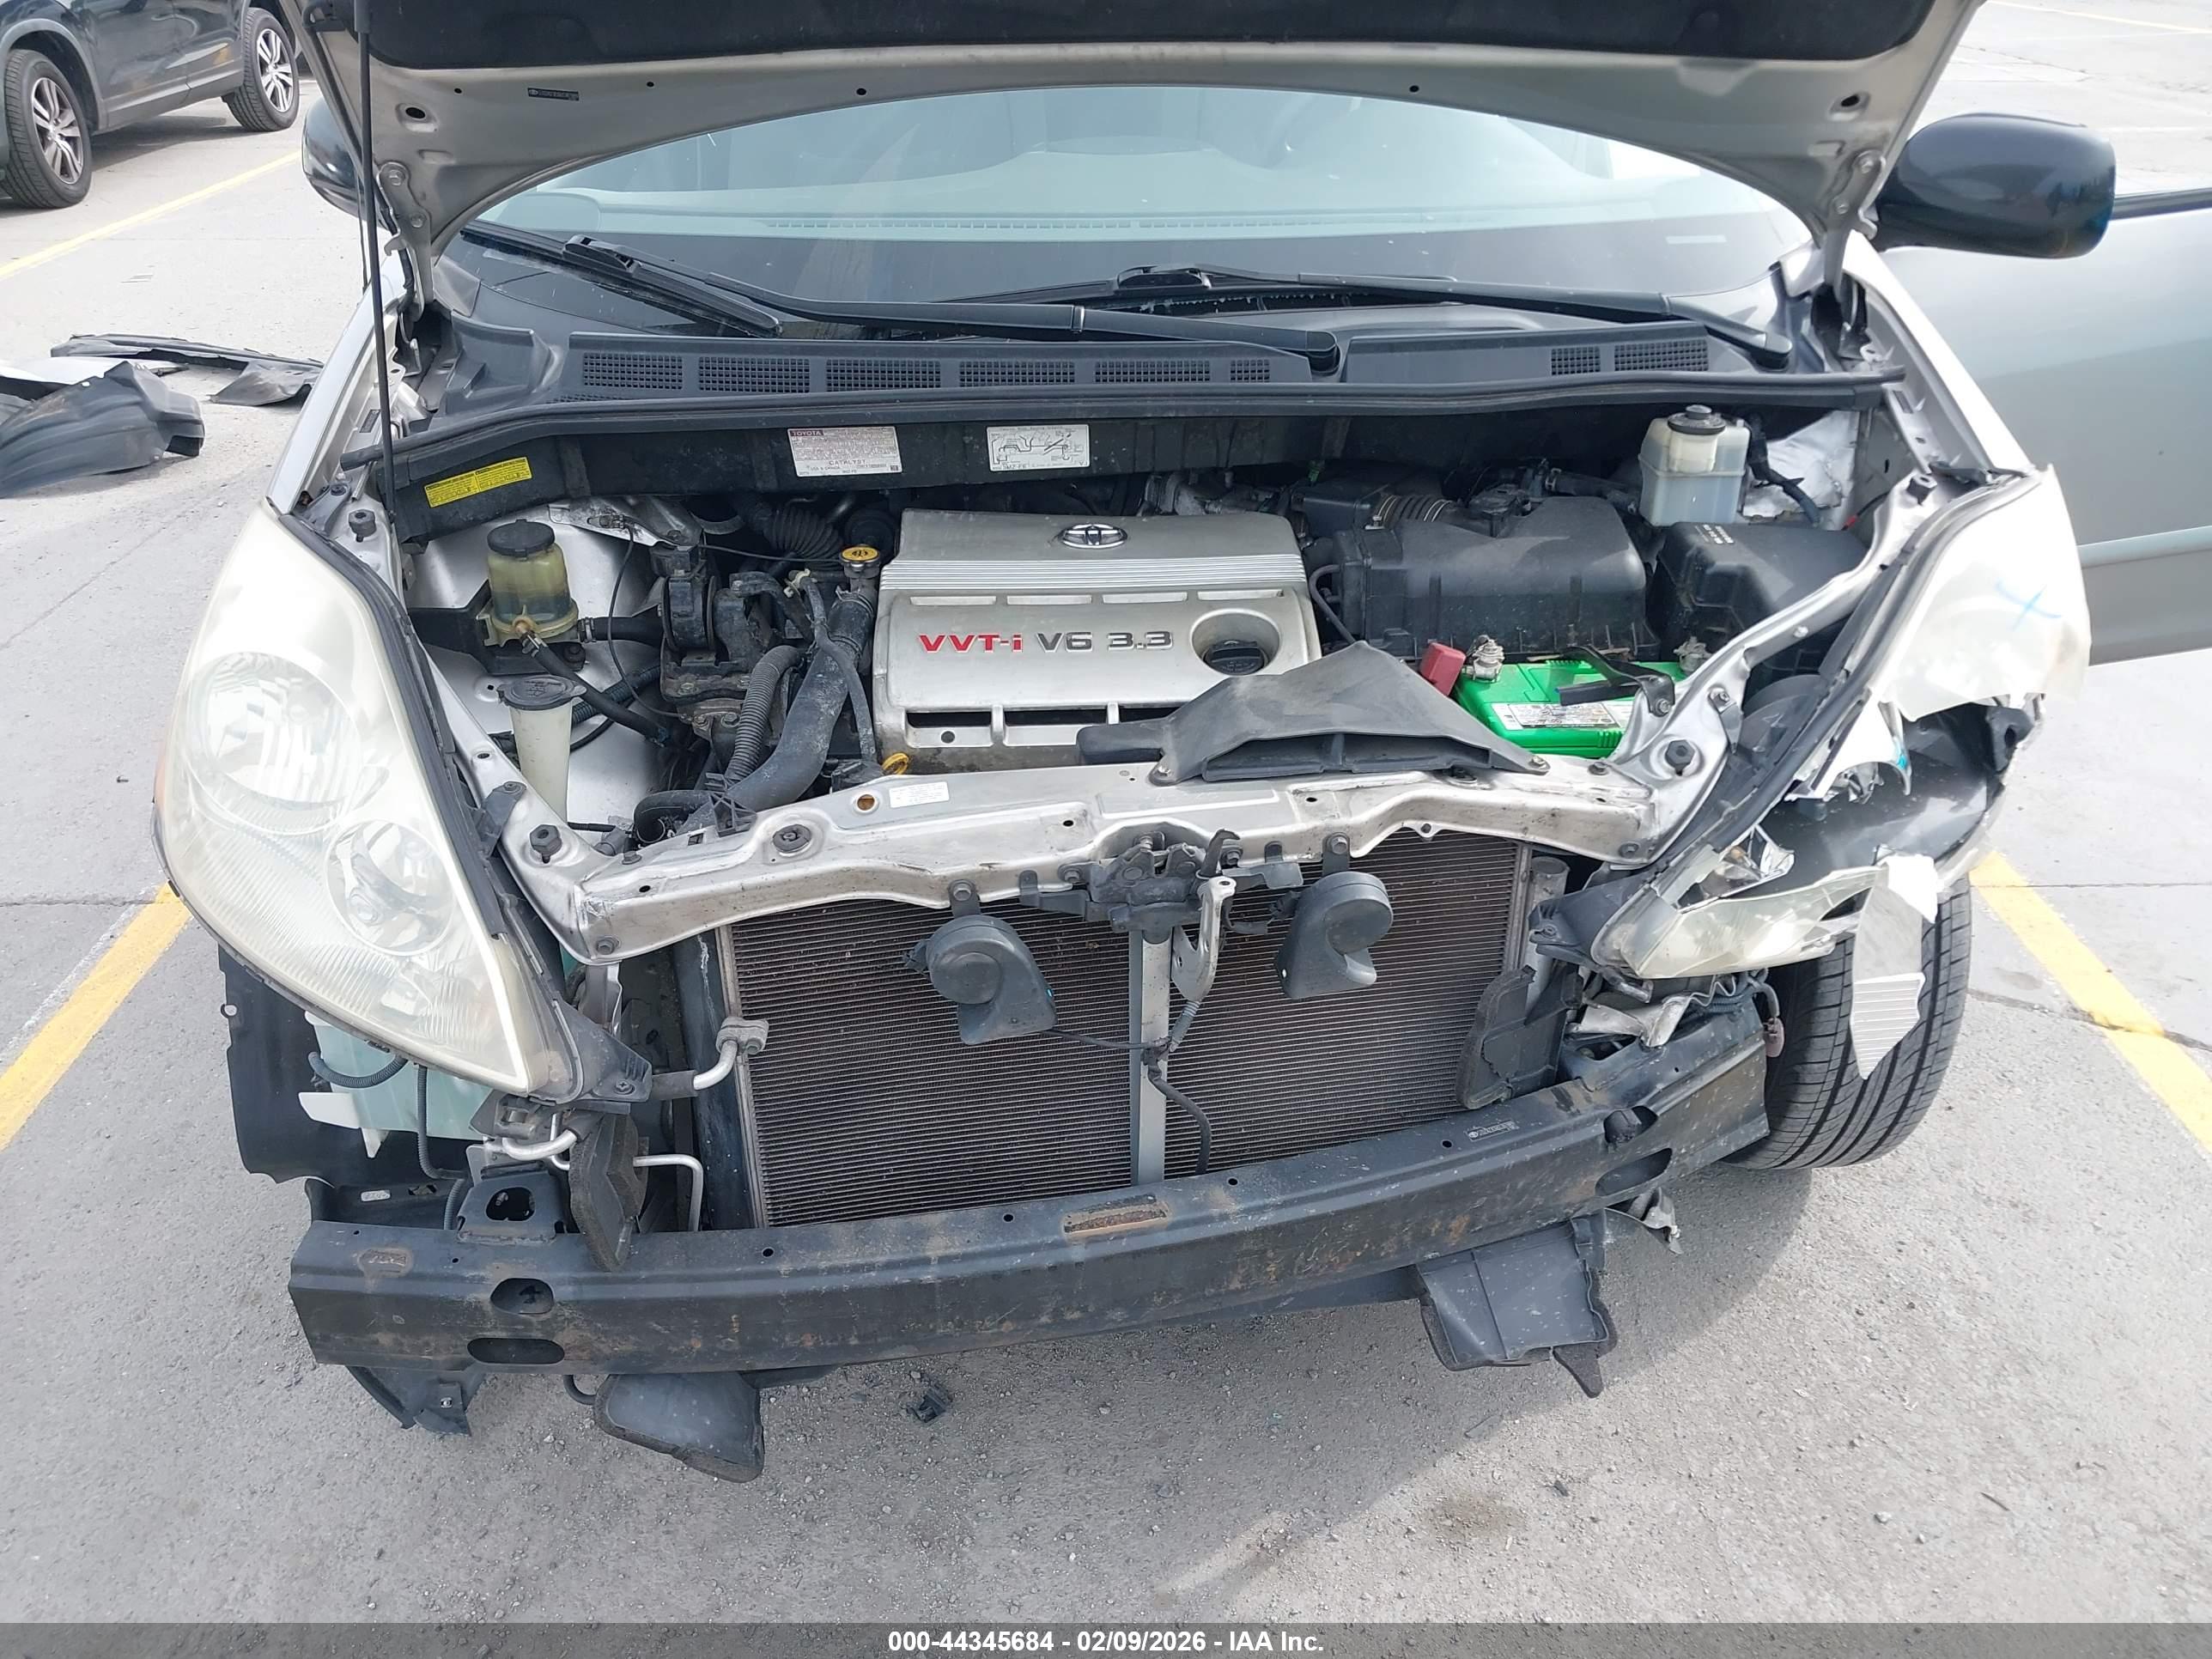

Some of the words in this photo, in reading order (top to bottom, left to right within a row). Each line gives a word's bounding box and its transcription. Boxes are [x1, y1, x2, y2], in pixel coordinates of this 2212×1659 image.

[919, 632, 1024, 653] VVT-i
[1036, 631, 1093, 653] V6
[1107, 630, 1174, 652] 3.3
